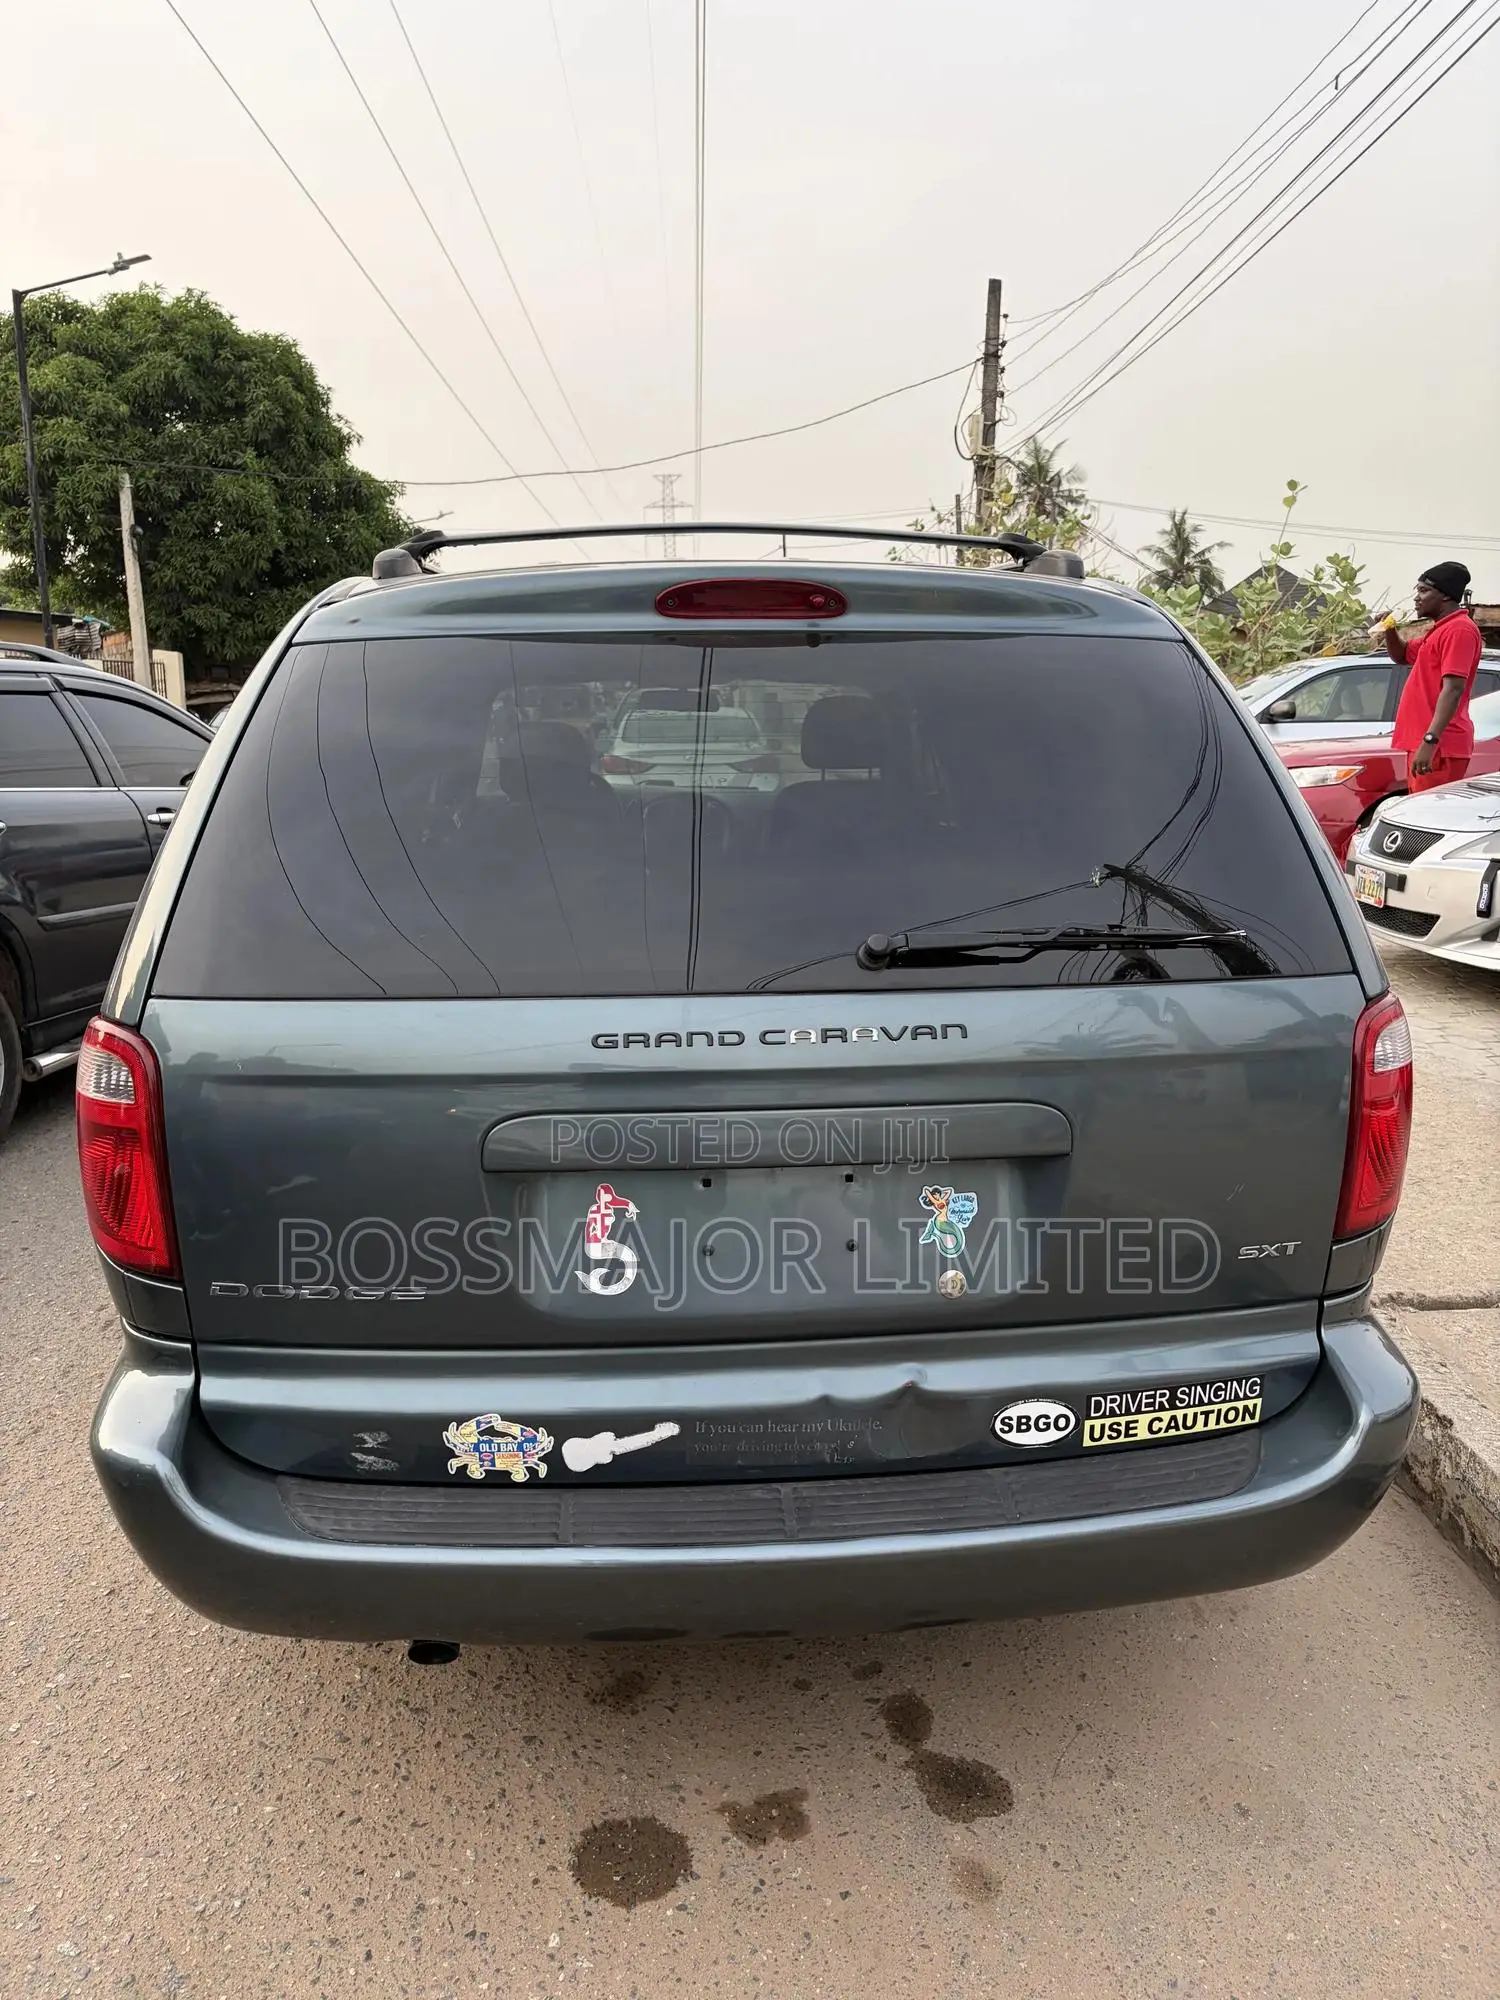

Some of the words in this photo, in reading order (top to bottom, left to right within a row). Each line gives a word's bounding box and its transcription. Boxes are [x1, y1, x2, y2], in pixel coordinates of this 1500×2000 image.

[591, 1030, 746, 1050] GRAND
[758, 1023, 969, 1046] CARAVAN
[1238, 1241, 1302, 1259] SXT
[210, 1281, 428, 1300] DODGE
[1090, 1389, 1170, 1417] DRIVER
[1175, 1377, 1261, 1408] SINGING
[709, 1424, 736, 1437] you
[767, 1419, 799, 1433] hear
[801, 1422, 824, 1436] my
[999, 1413, 1071, 1434] SBGO
[1089, 1419, 1139, 1443] USE
[1147, 1402, 1258, 1436] CAUTION
[479, 1442, 498, 1452] OLD
[500, 1442, 518, 1452] BAY
